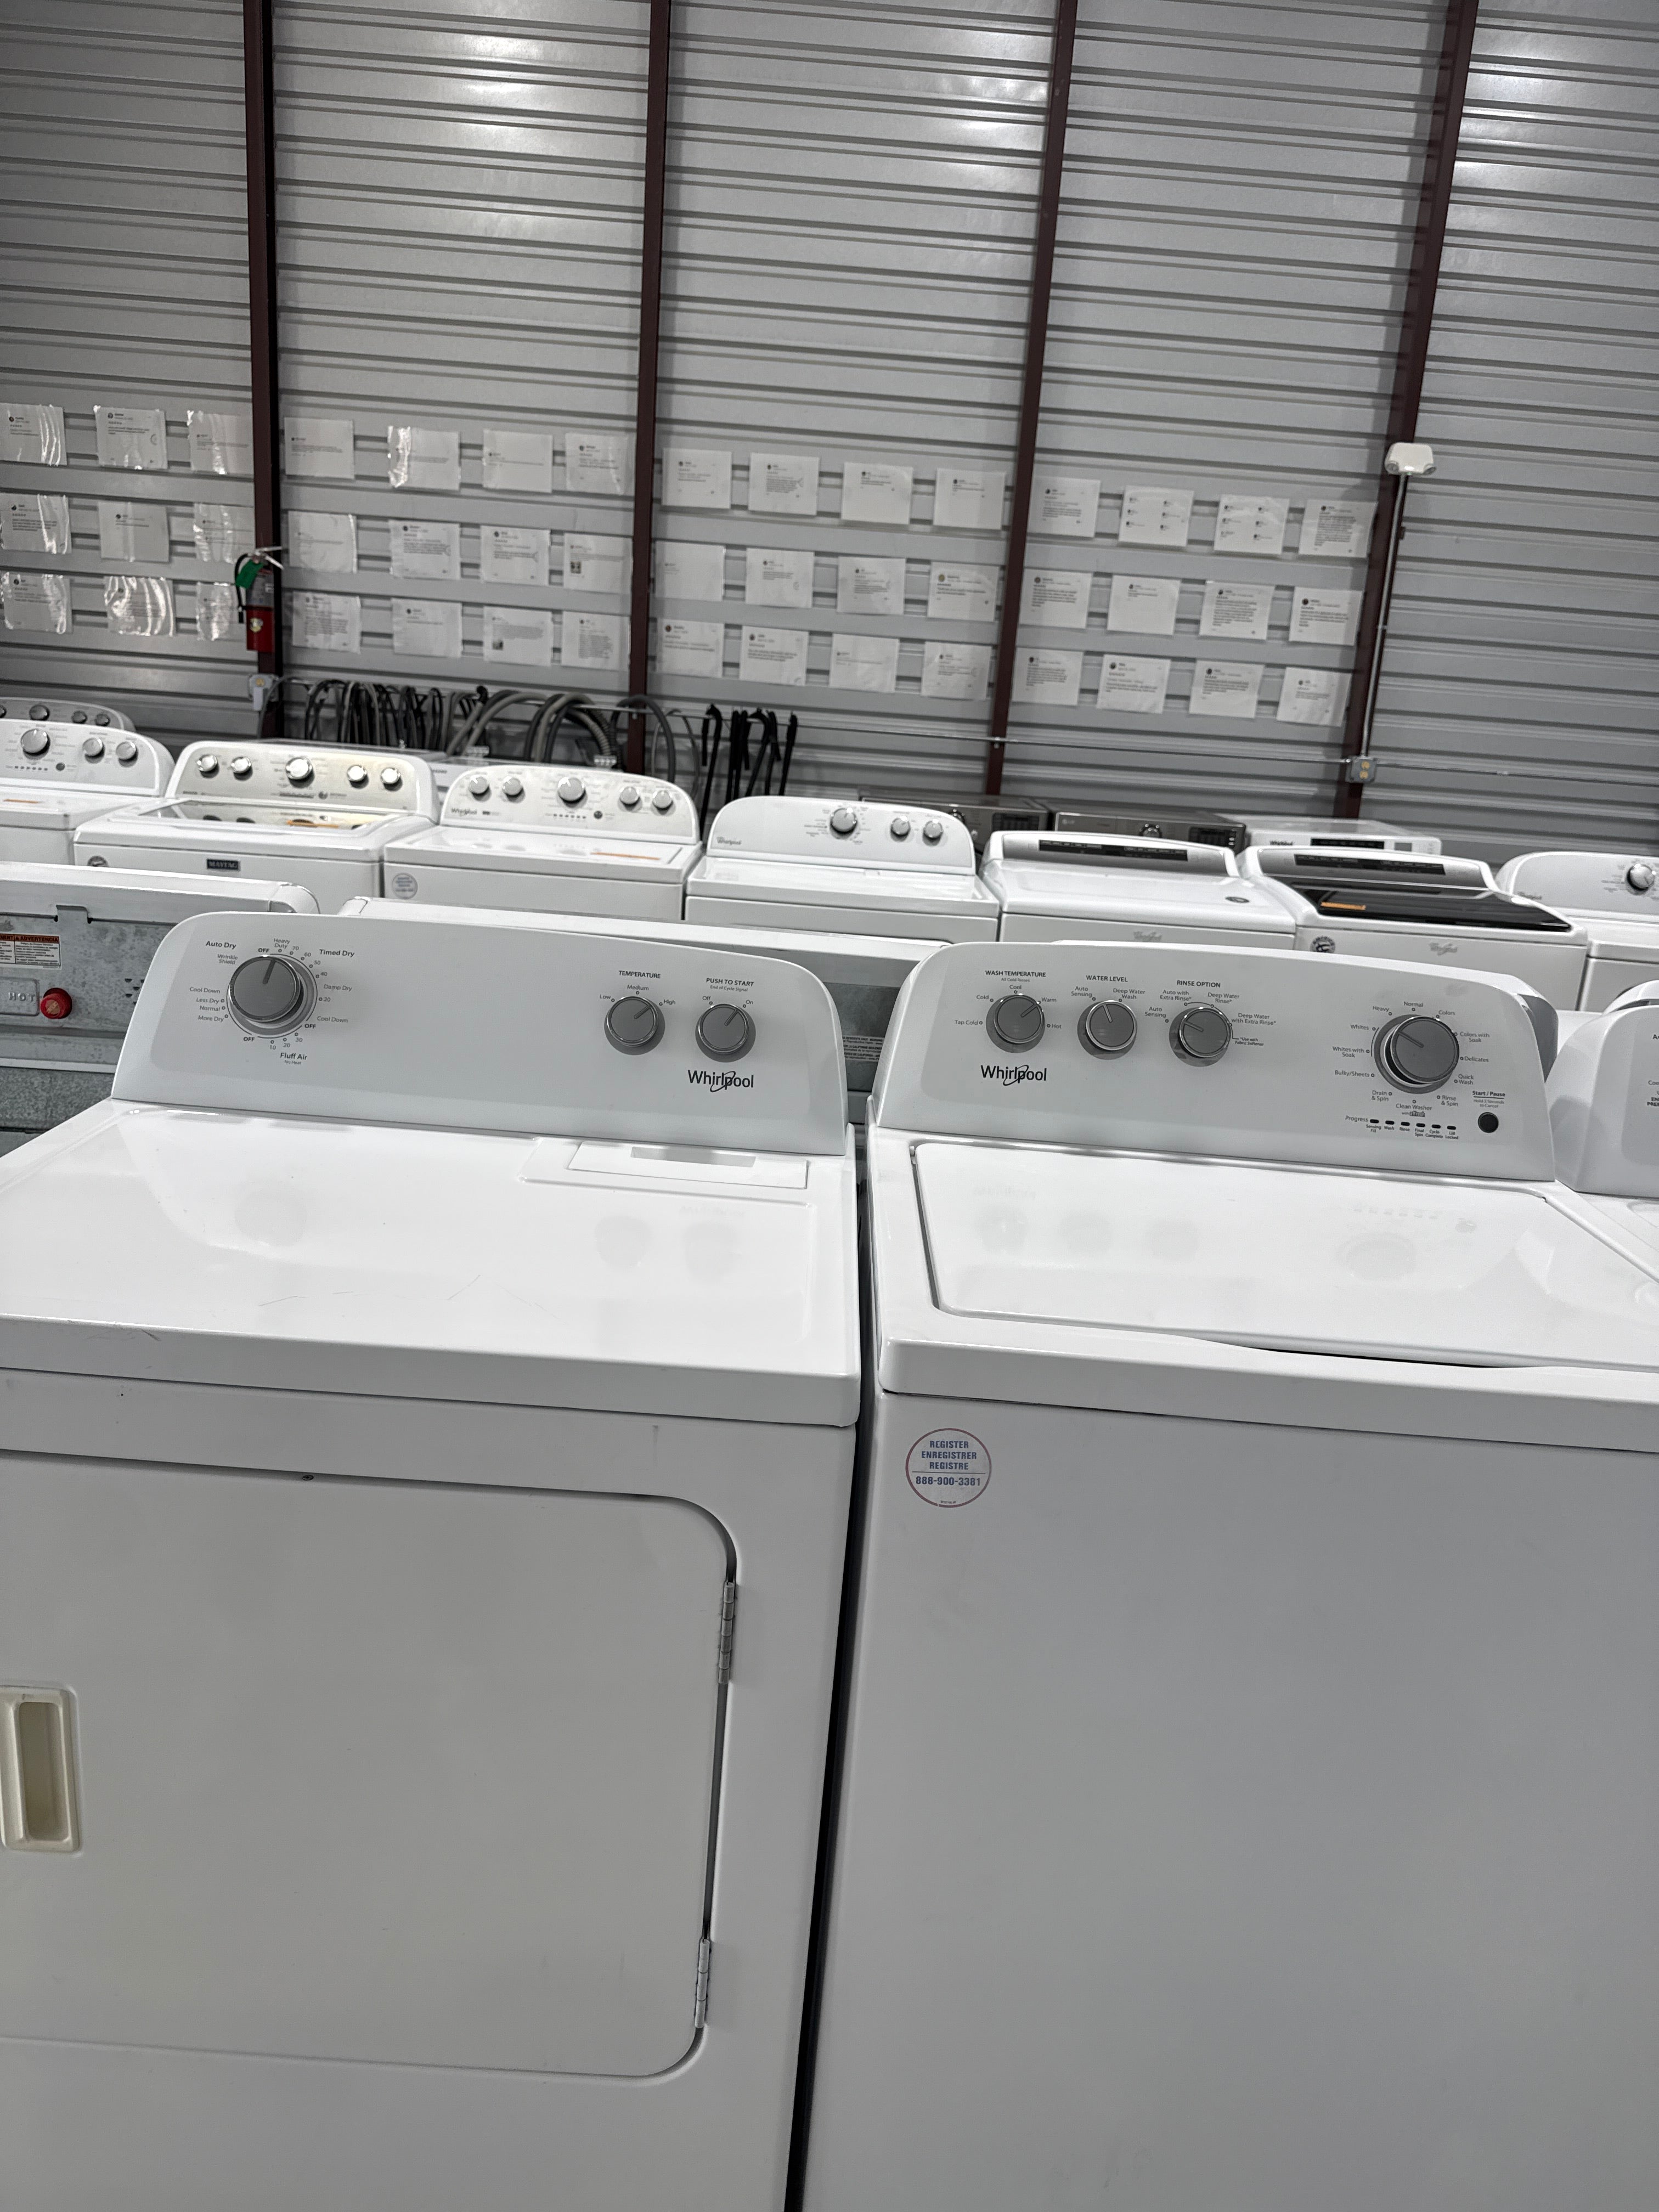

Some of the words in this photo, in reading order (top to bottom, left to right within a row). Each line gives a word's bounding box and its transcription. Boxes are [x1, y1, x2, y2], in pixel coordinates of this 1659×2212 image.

[619, 970, 661, 979] TEMPERATURE
[8, 992, 36, 1001] HOT
[980, 1064, 1047, 1086] Whirlpool
[688, 1069, 754, 1092] Whirlpool
[921, 1451, 977, 1459] ENREGISTRER
[916, 1476, 980, 1486] 888-900-3381
